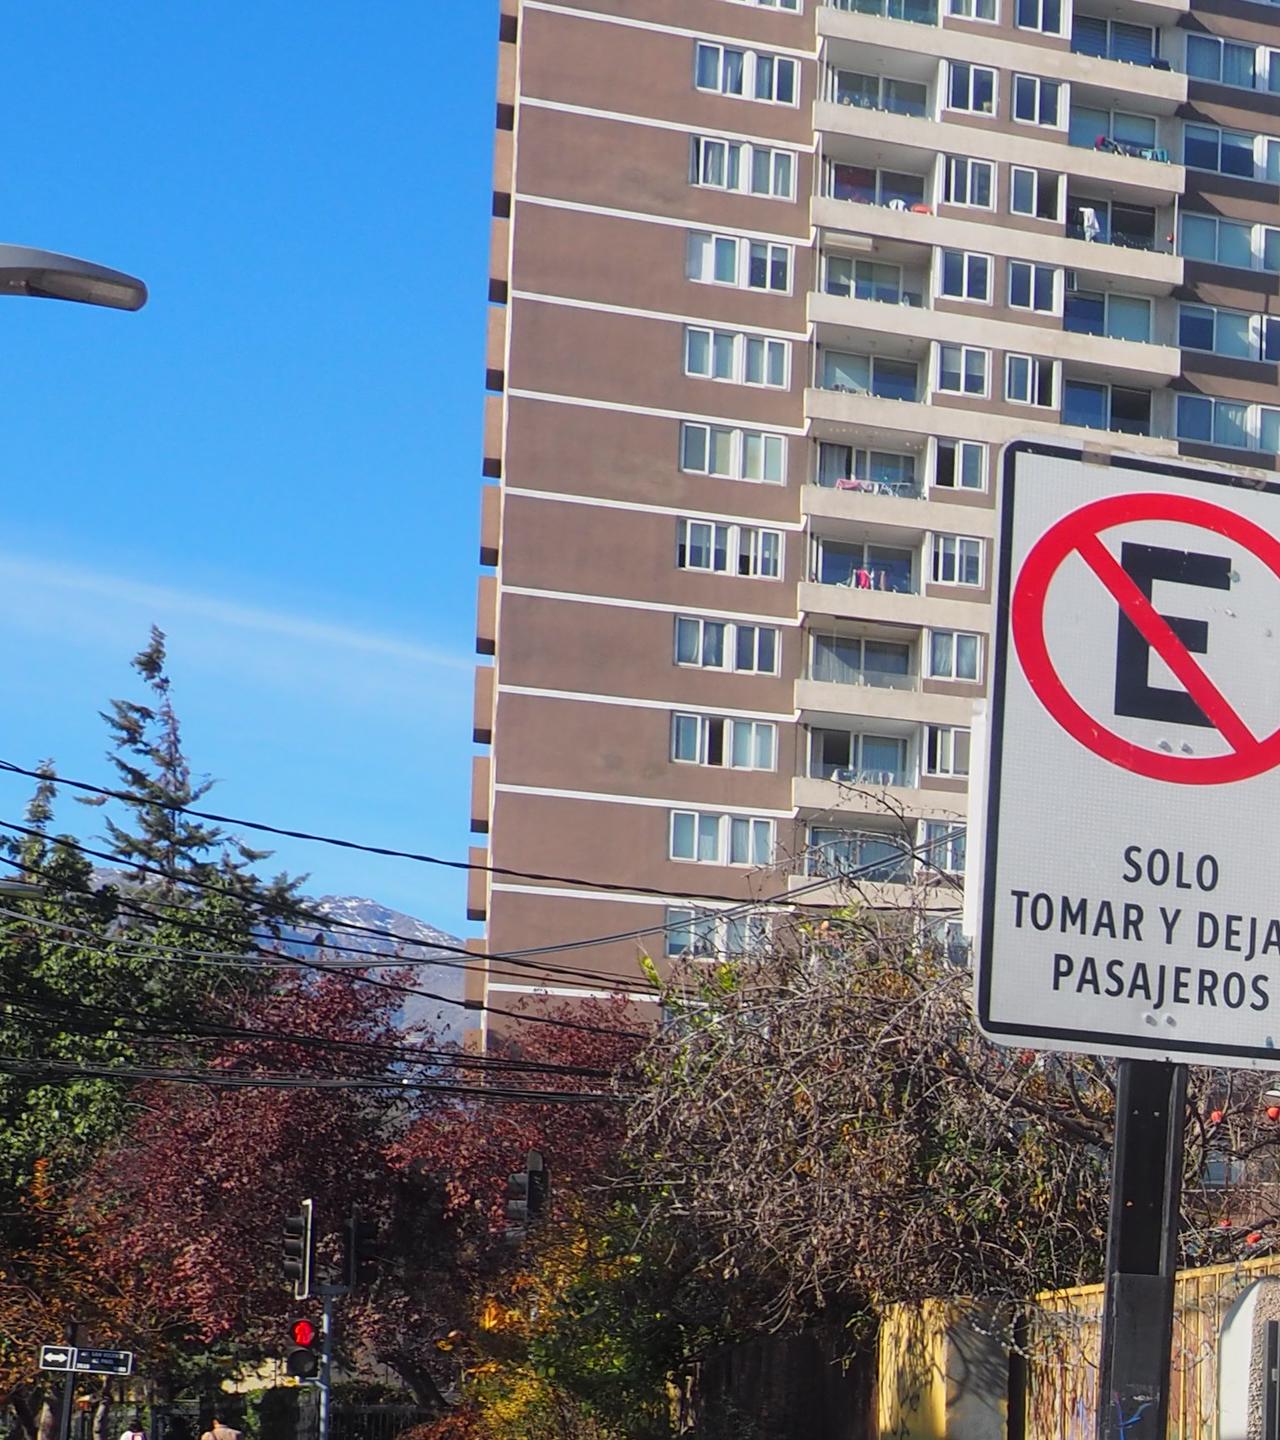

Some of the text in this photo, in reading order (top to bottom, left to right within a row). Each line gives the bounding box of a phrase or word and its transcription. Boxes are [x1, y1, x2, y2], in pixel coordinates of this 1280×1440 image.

[1123, 845, 1219, 892] SOLO
[1011, 890, 1144, 942] TOMAR
[1160, 907, 1182, 944] Y
[1053, 954, 1270, 1012] PASAJEROS
